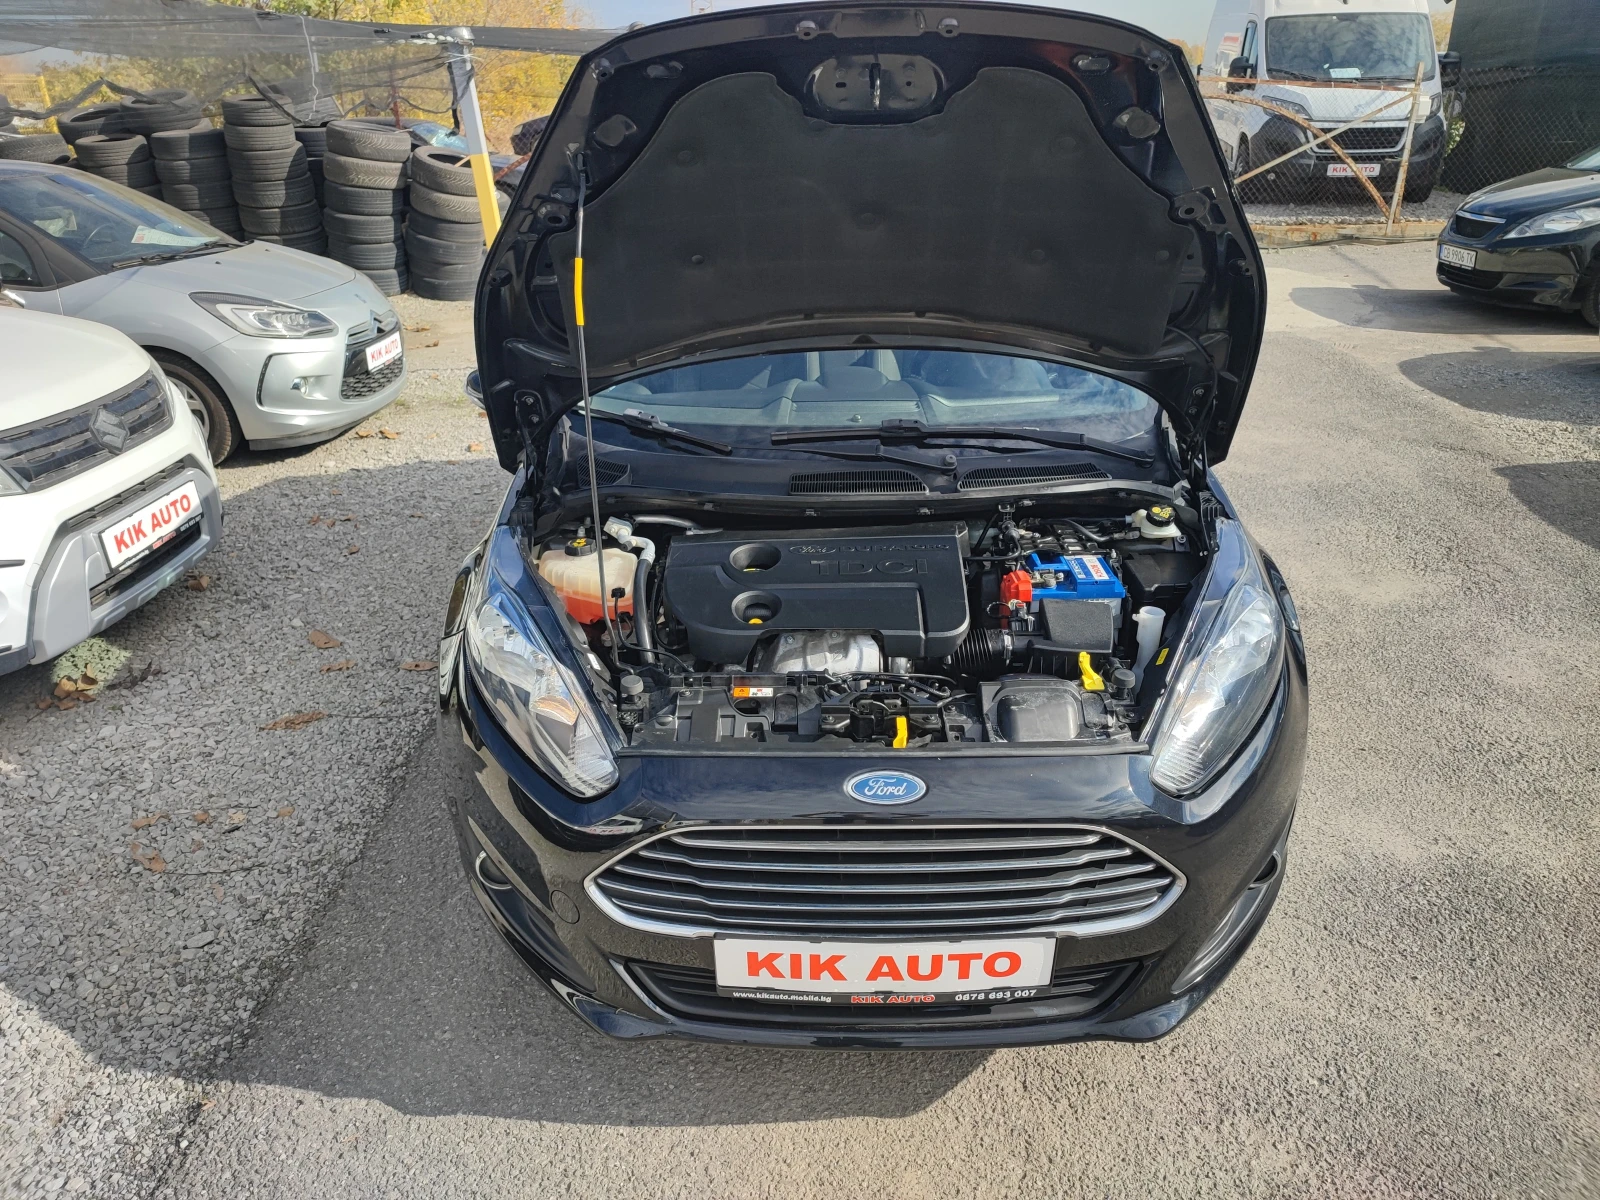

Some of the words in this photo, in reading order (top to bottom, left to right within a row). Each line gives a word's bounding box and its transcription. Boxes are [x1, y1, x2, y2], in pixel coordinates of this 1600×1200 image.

[371, 348, 383, 363] KIK
[384, 338, 399, 356] AUTO
[114, 519, 148, 554] KIK
[151, 494, 191, 533] AUTO
[864, 778, 907, 796] Ford
[747, 951, 848, 981] KIK
[865, 951, 1022, 981] AUTO
[851, 994, 884, 1004] KIK
[887, 994, 936, 1003] AUTO
[955, 992, 985, 1002] 0878
[988, 991, 1011, 1000] 693
[1014, 989, 1037, 998] 007
